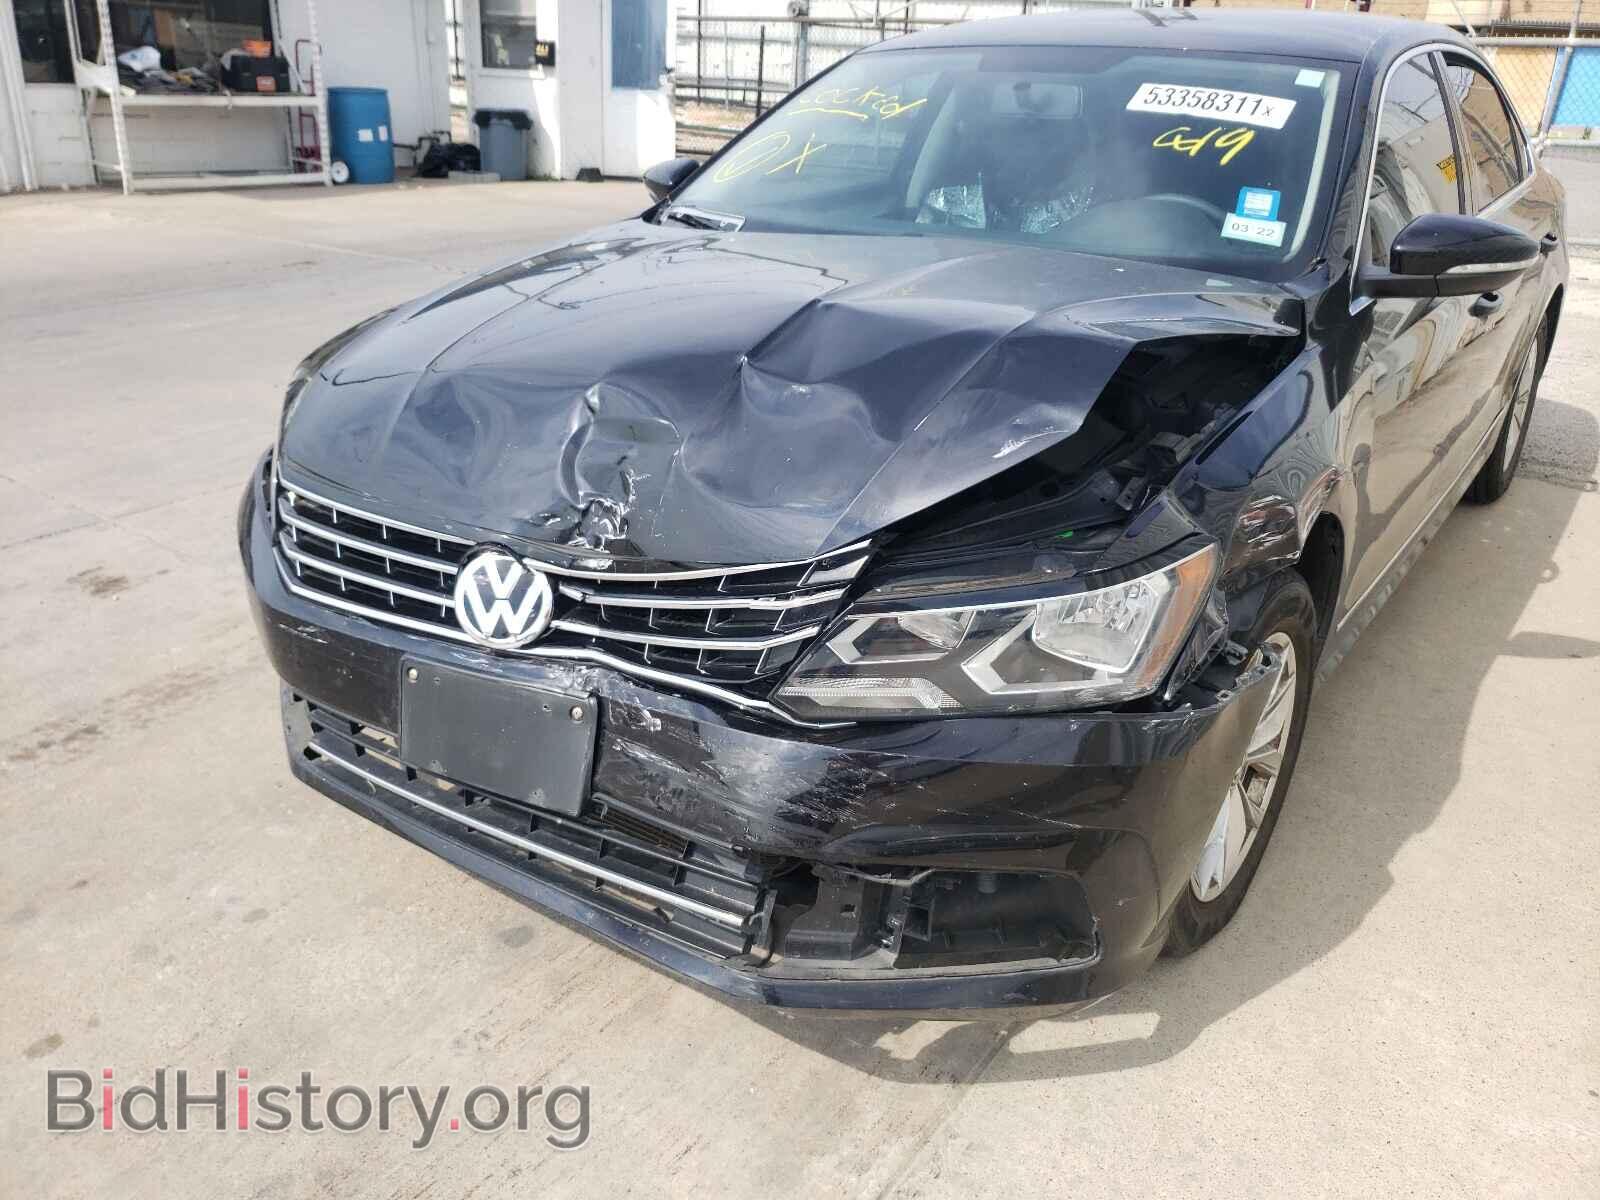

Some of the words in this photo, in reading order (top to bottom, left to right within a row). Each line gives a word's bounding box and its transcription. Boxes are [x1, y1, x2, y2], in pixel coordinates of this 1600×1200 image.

[1144, 87, 1263, 116] 53358311
[1231, 222, 1249, 233] 03
[1256, 227, 1276, 237] 22
